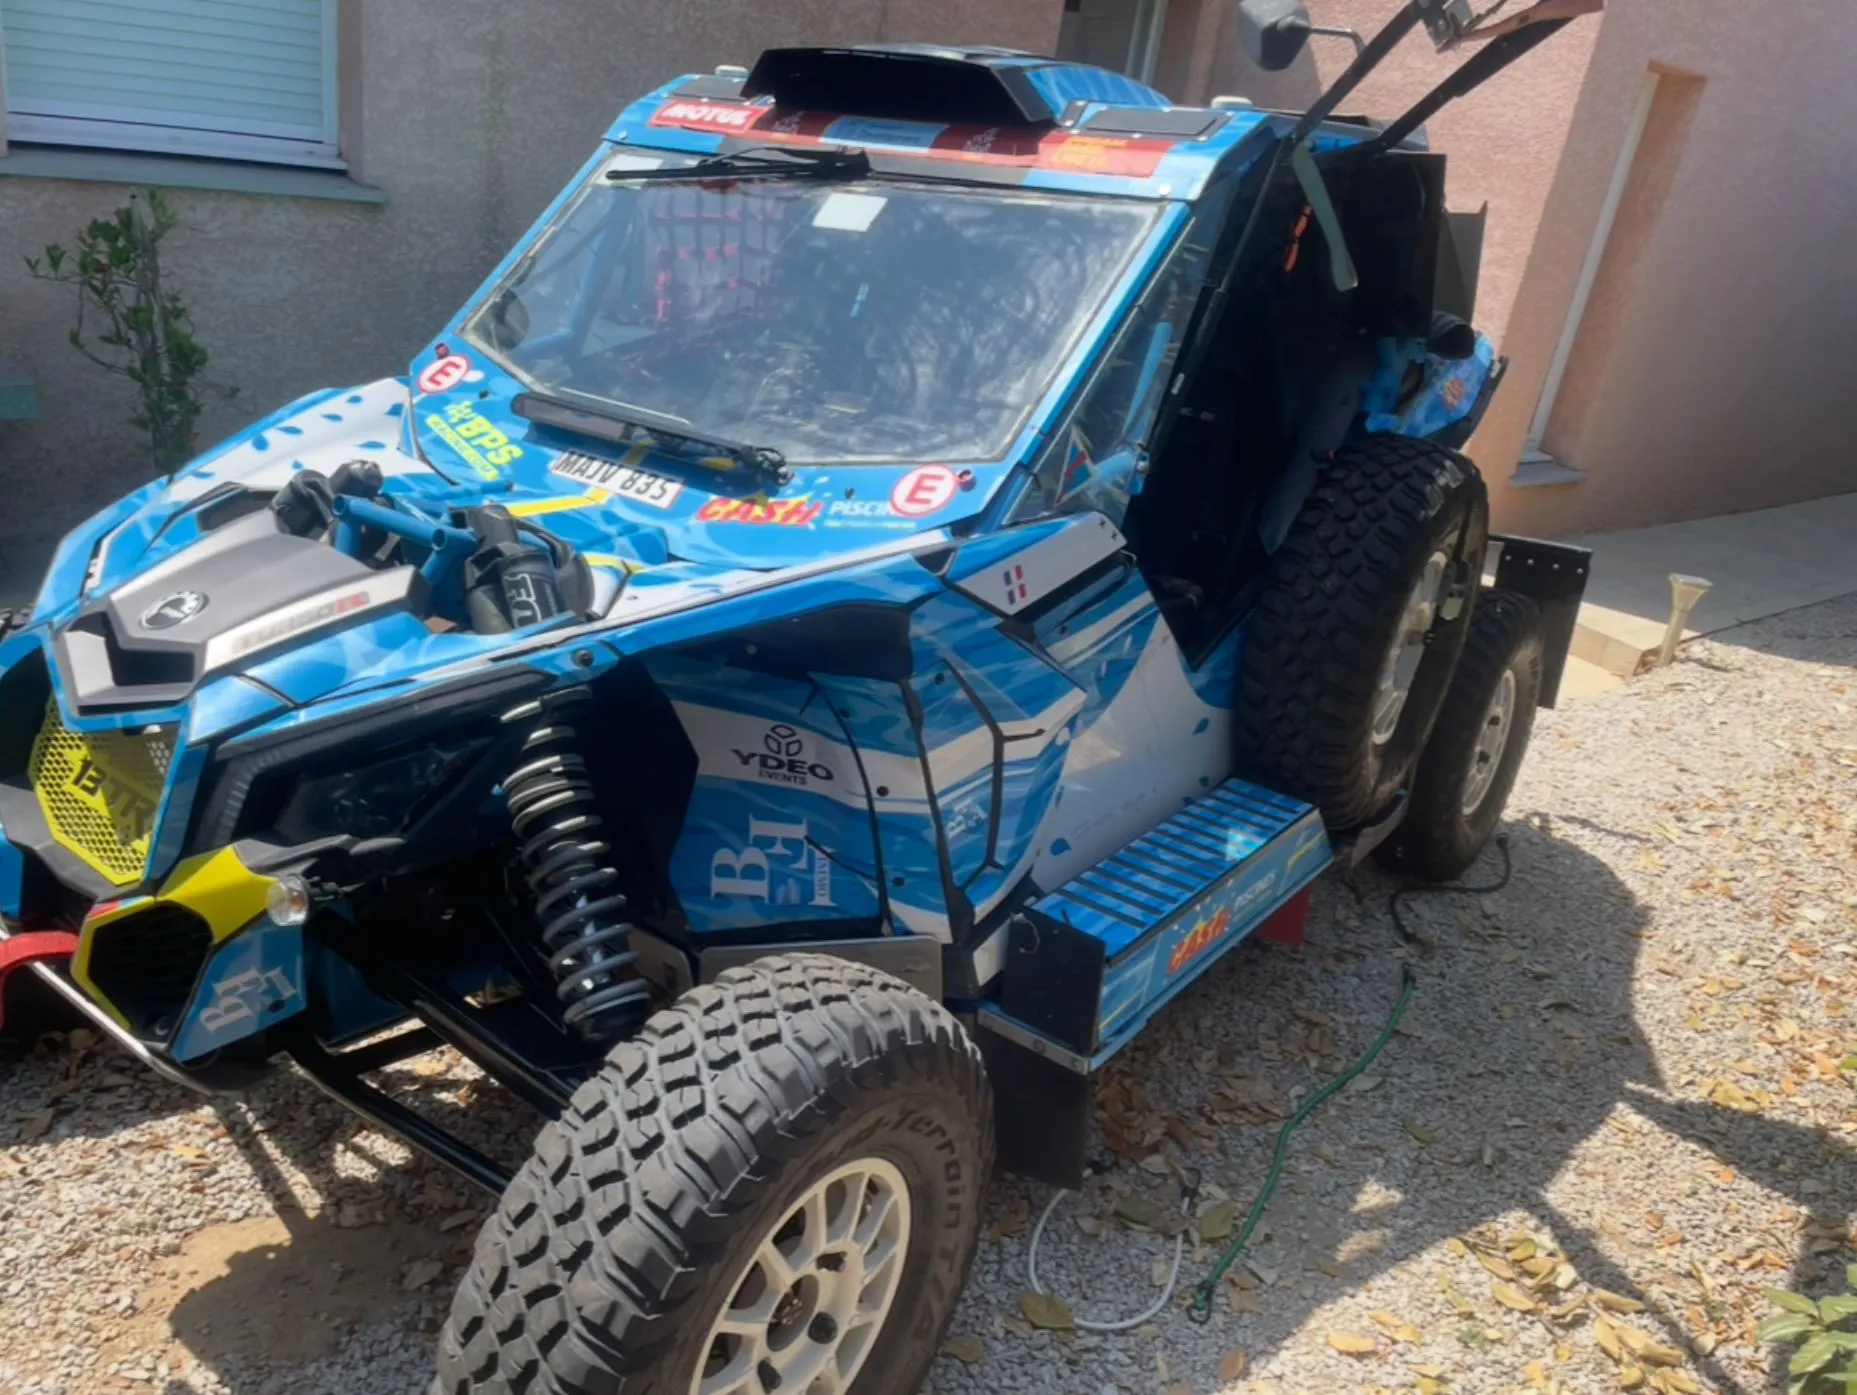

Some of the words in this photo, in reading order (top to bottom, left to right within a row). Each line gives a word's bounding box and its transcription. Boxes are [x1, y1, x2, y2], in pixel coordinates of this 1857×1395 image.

[661, 103, 753, 126] MOTUL
[427, 360, 462, 387] E
[904, 473, 945, 505] E
[695, 496, 824, 527] CASH
[729, 748, 834, 780] YDEO
[759, 769, 808, 786] EVENTS
